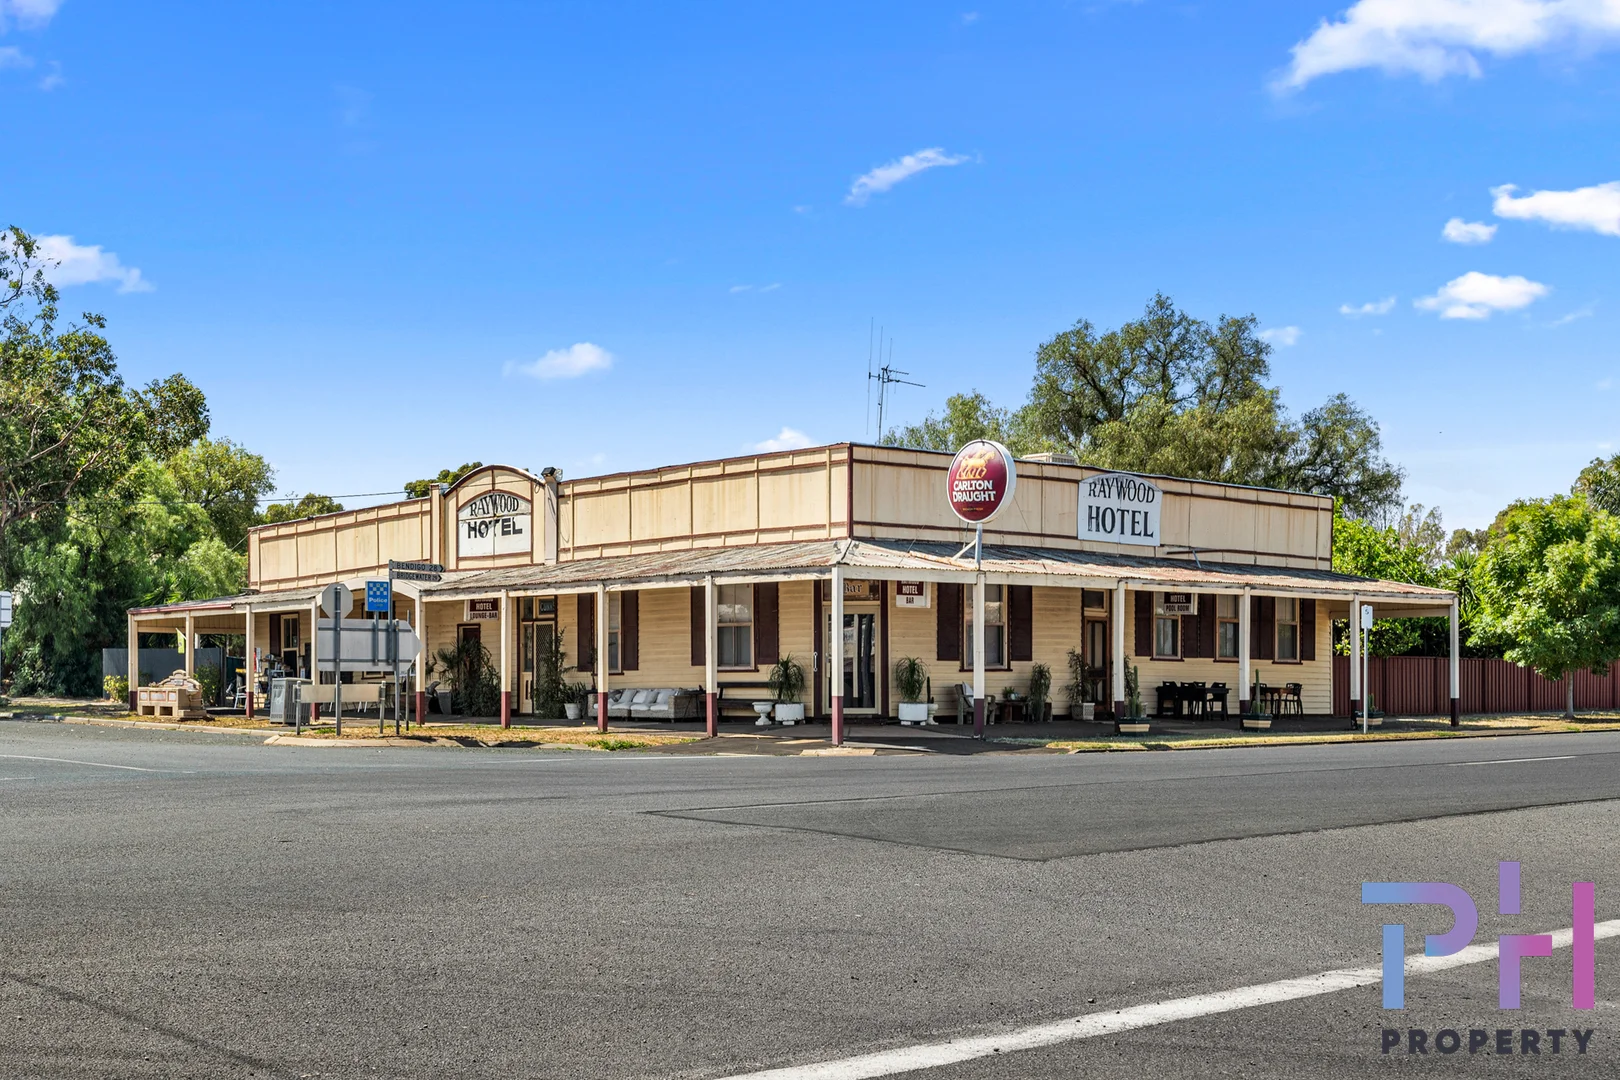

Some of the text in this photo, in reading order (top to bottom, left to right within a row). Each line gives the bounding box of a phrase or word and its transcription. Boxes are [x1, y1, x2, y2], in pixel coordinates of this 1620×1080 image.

[953, 480, 993, 491] CARLTON
[1088, 477, 1155, 503] RAYWOOD
[952, 491, 996, 502] DRAUGHT
[469, 494, 519, 517] RAYWOOD
[1087, 505, 1154, 538] HOTEL
[467, 517, 523, 539] HOTEL
[396, 562, 439, 572] BENDIGO 28
[396, 572, 431, 581] BRIDGEWATER
[902, 585, 919, 594] HOTEL
[905, 596, 915, 604] BAR
[1170, 594, 1186, 603] HOTEL
[475, 602, 493, 611] HOTEL
[469, 611, 498, 620] LOUNGE-BAR
